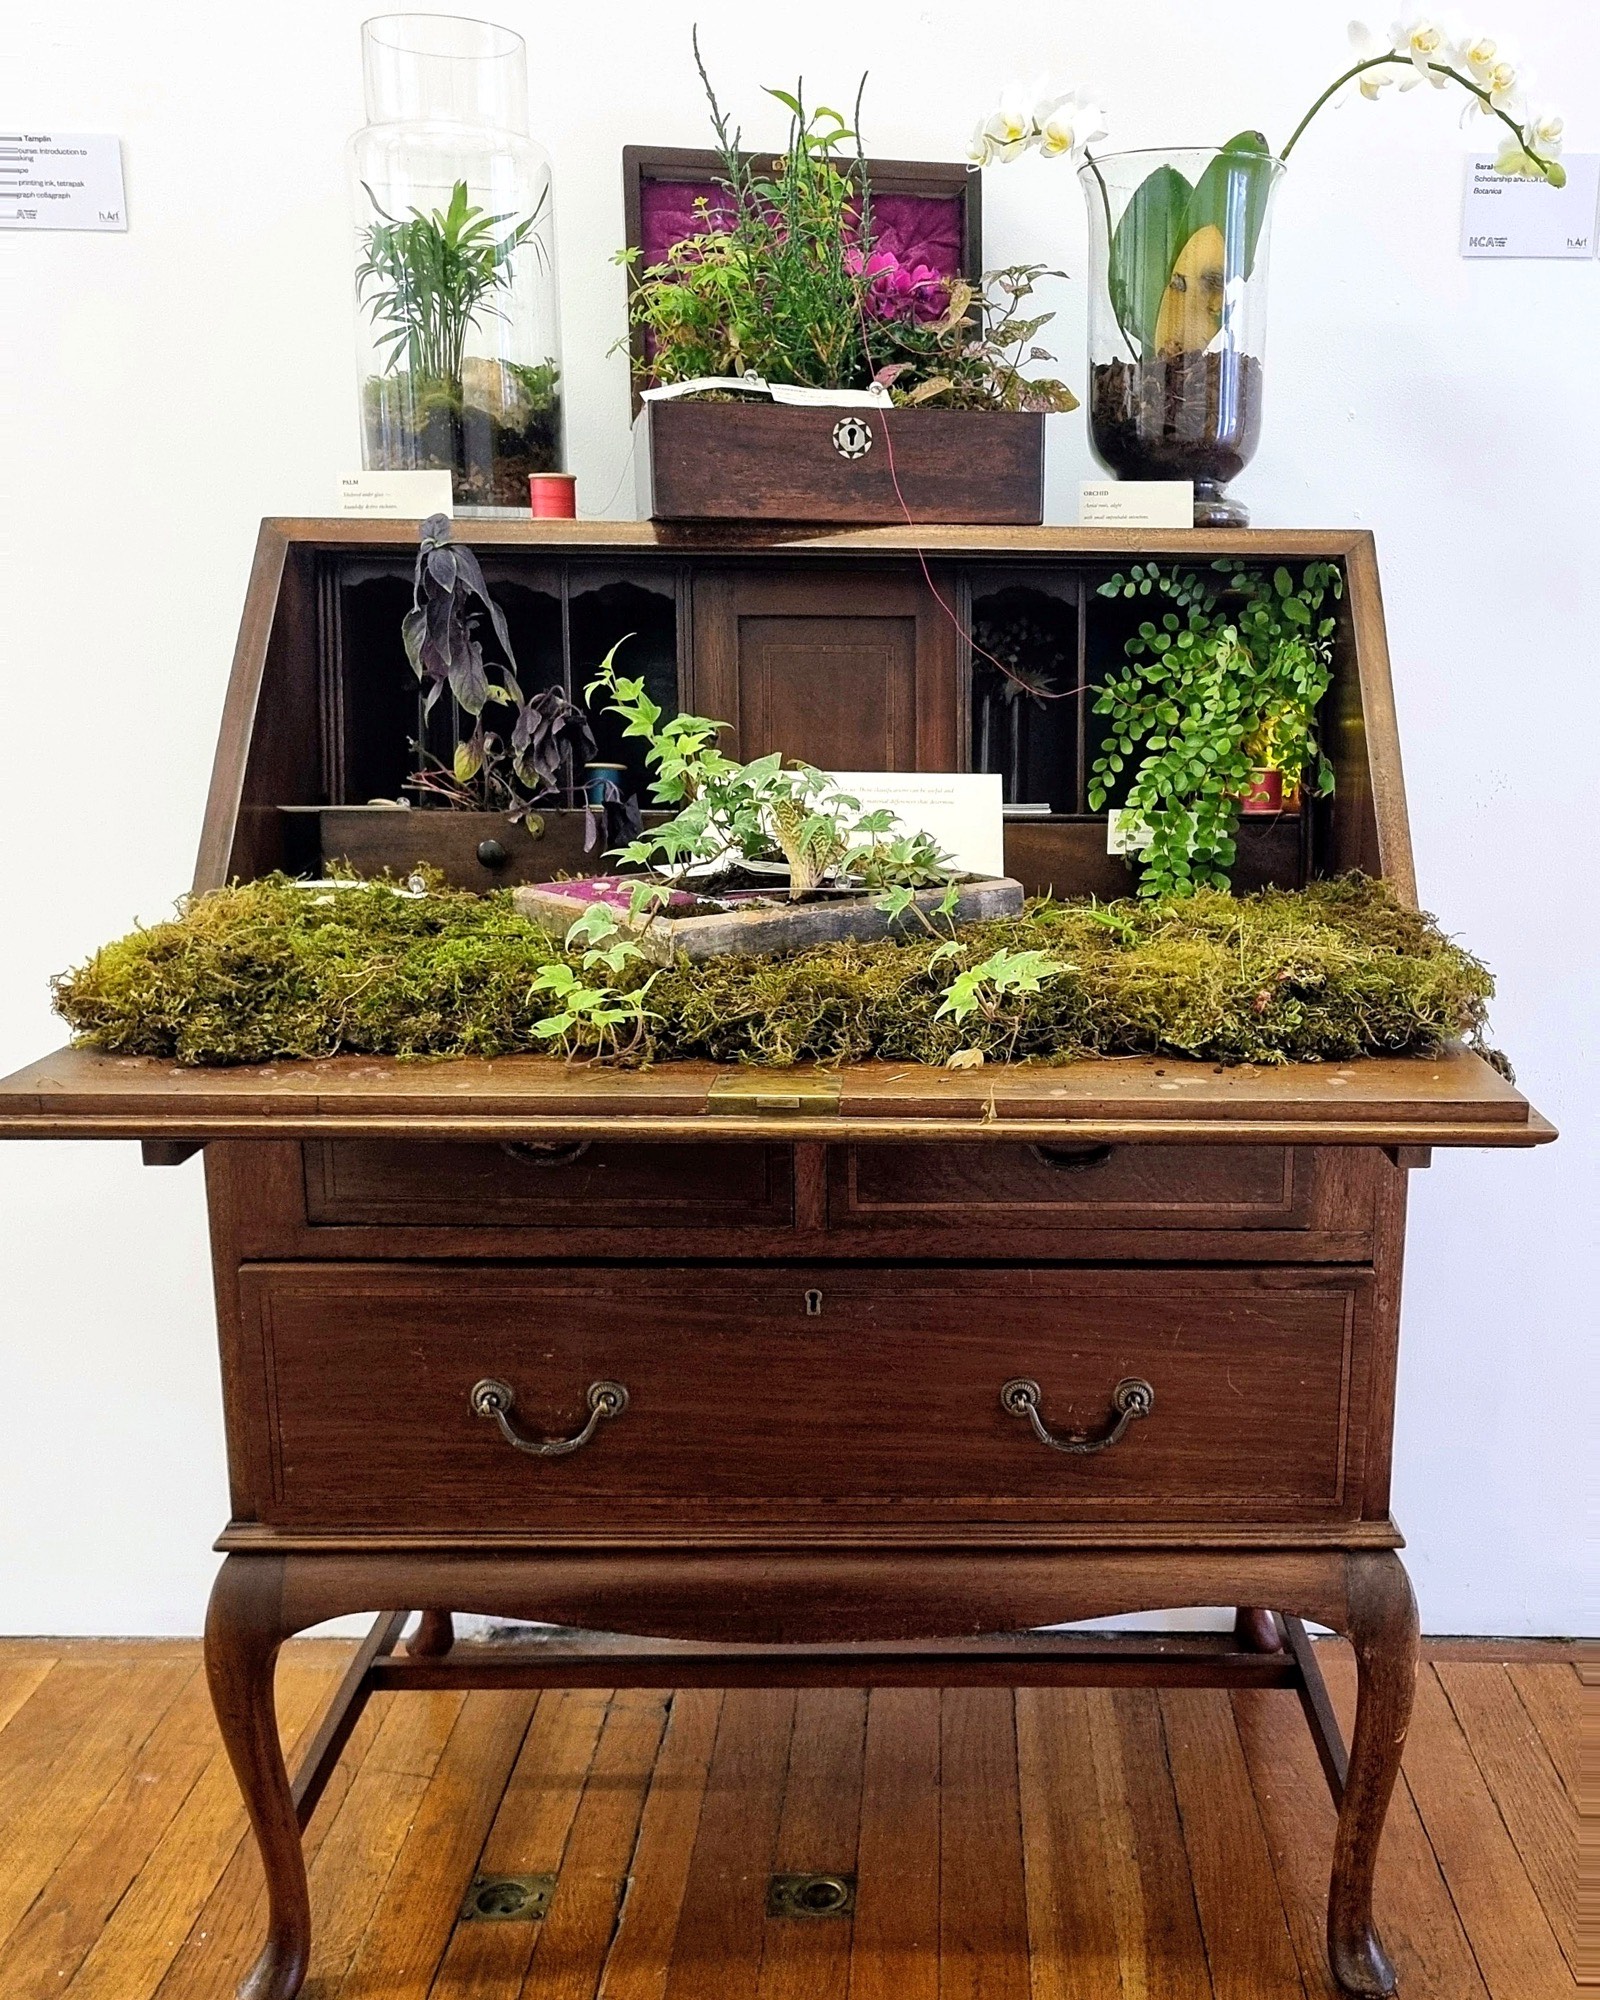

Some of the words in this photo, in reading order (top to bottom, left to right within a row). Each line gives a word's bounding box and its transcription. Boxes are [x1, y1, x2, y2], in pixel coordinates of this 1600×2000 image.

[39, 148, 80, 156] Introduction
[1474, 175, 1512, 184] Scholarship
[18, 180, 44, 188] printing
[1473, 187, 1502, 195] Botanica
